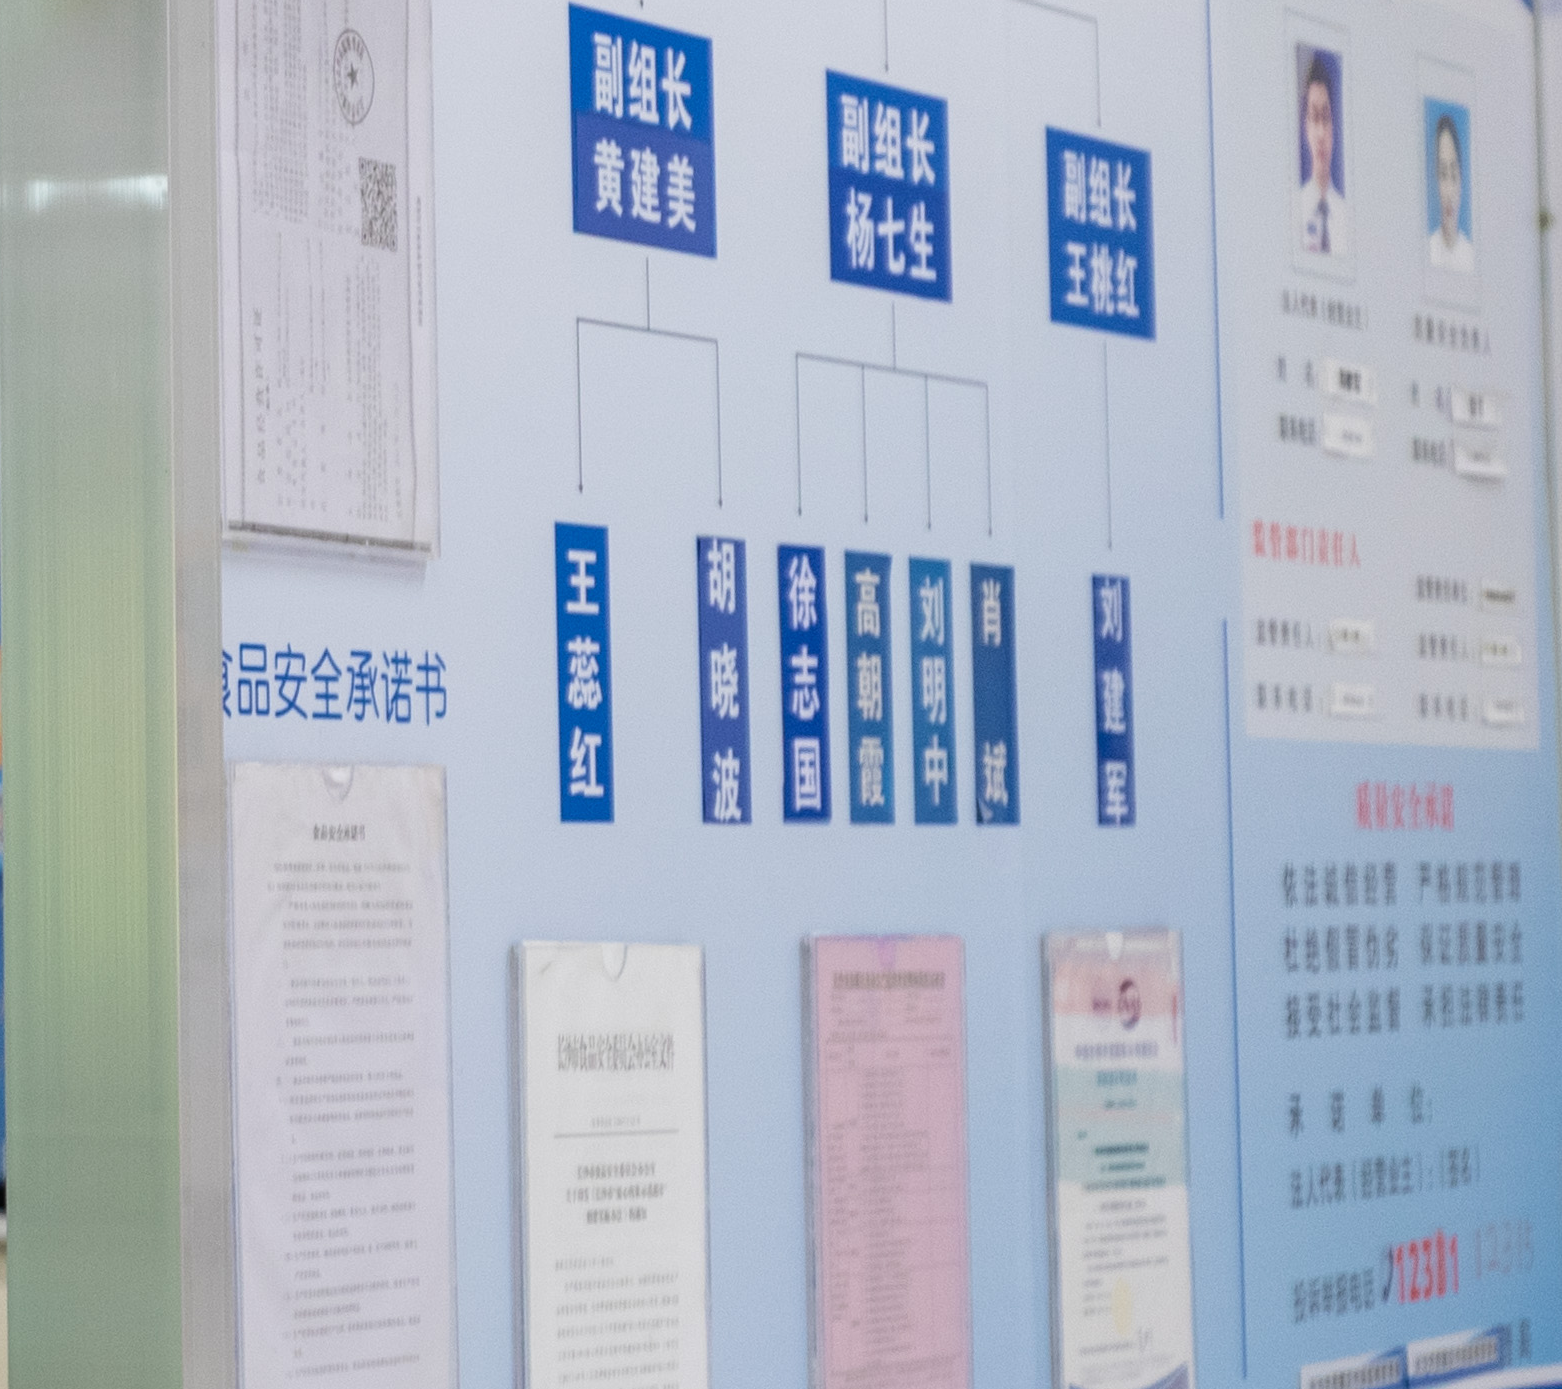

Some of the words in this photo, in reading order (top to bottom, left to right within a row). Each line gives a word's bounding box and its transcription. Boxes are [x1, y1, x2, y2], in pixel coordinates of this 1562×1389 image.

[593, 32, 692, 132] 副组长
[593, 138, 697, 233] 黄建美
[840, 93, 936, 186] 副组长
[846, 186, 938, 282] 杨七生
[1062, 149, 1137, 233] 副组长
[565, 548, 605, 799] 王蕊红
[706, 540, 743, 823] 胡晓波
[788, 554, 822, 812] 徐志国
[918, 574, 949, 808] 刘明中
